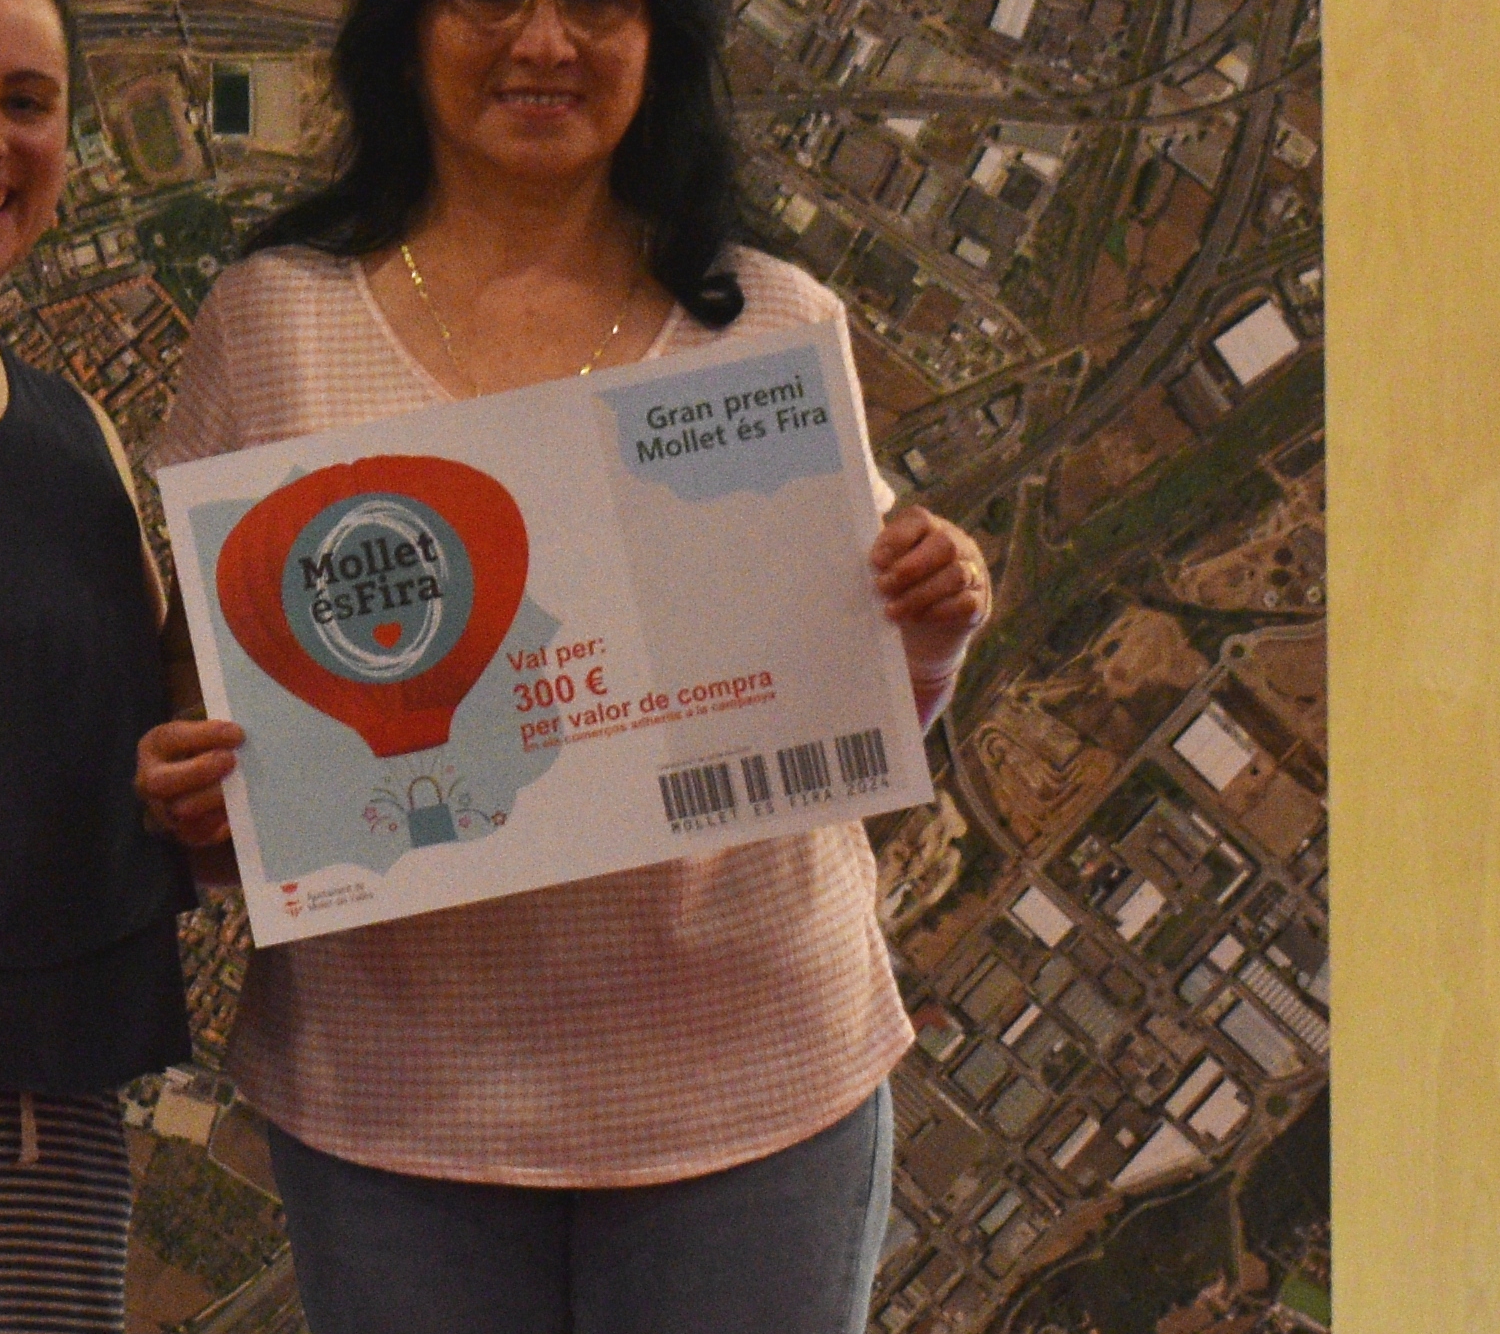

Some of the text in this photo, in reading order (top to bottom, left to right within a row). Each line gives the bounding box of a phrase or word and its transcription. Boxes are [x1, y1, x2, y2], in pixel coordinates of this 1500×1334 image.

[646, 374, 804, 430] Gran premi
[635, 405, 828, 464] Mollet és Fira
[299, 531, 439, 592] Mollet
[312, 573, 444, 625] ésFira
[506, 636, 606, 673] Val per:
[513, 665, 609, 713] 300 €
[521, 671, 773, 745] per valor de compra
[670, 806, 737, 834] MOLLET
[788, 789, 833, 809] FIRA
